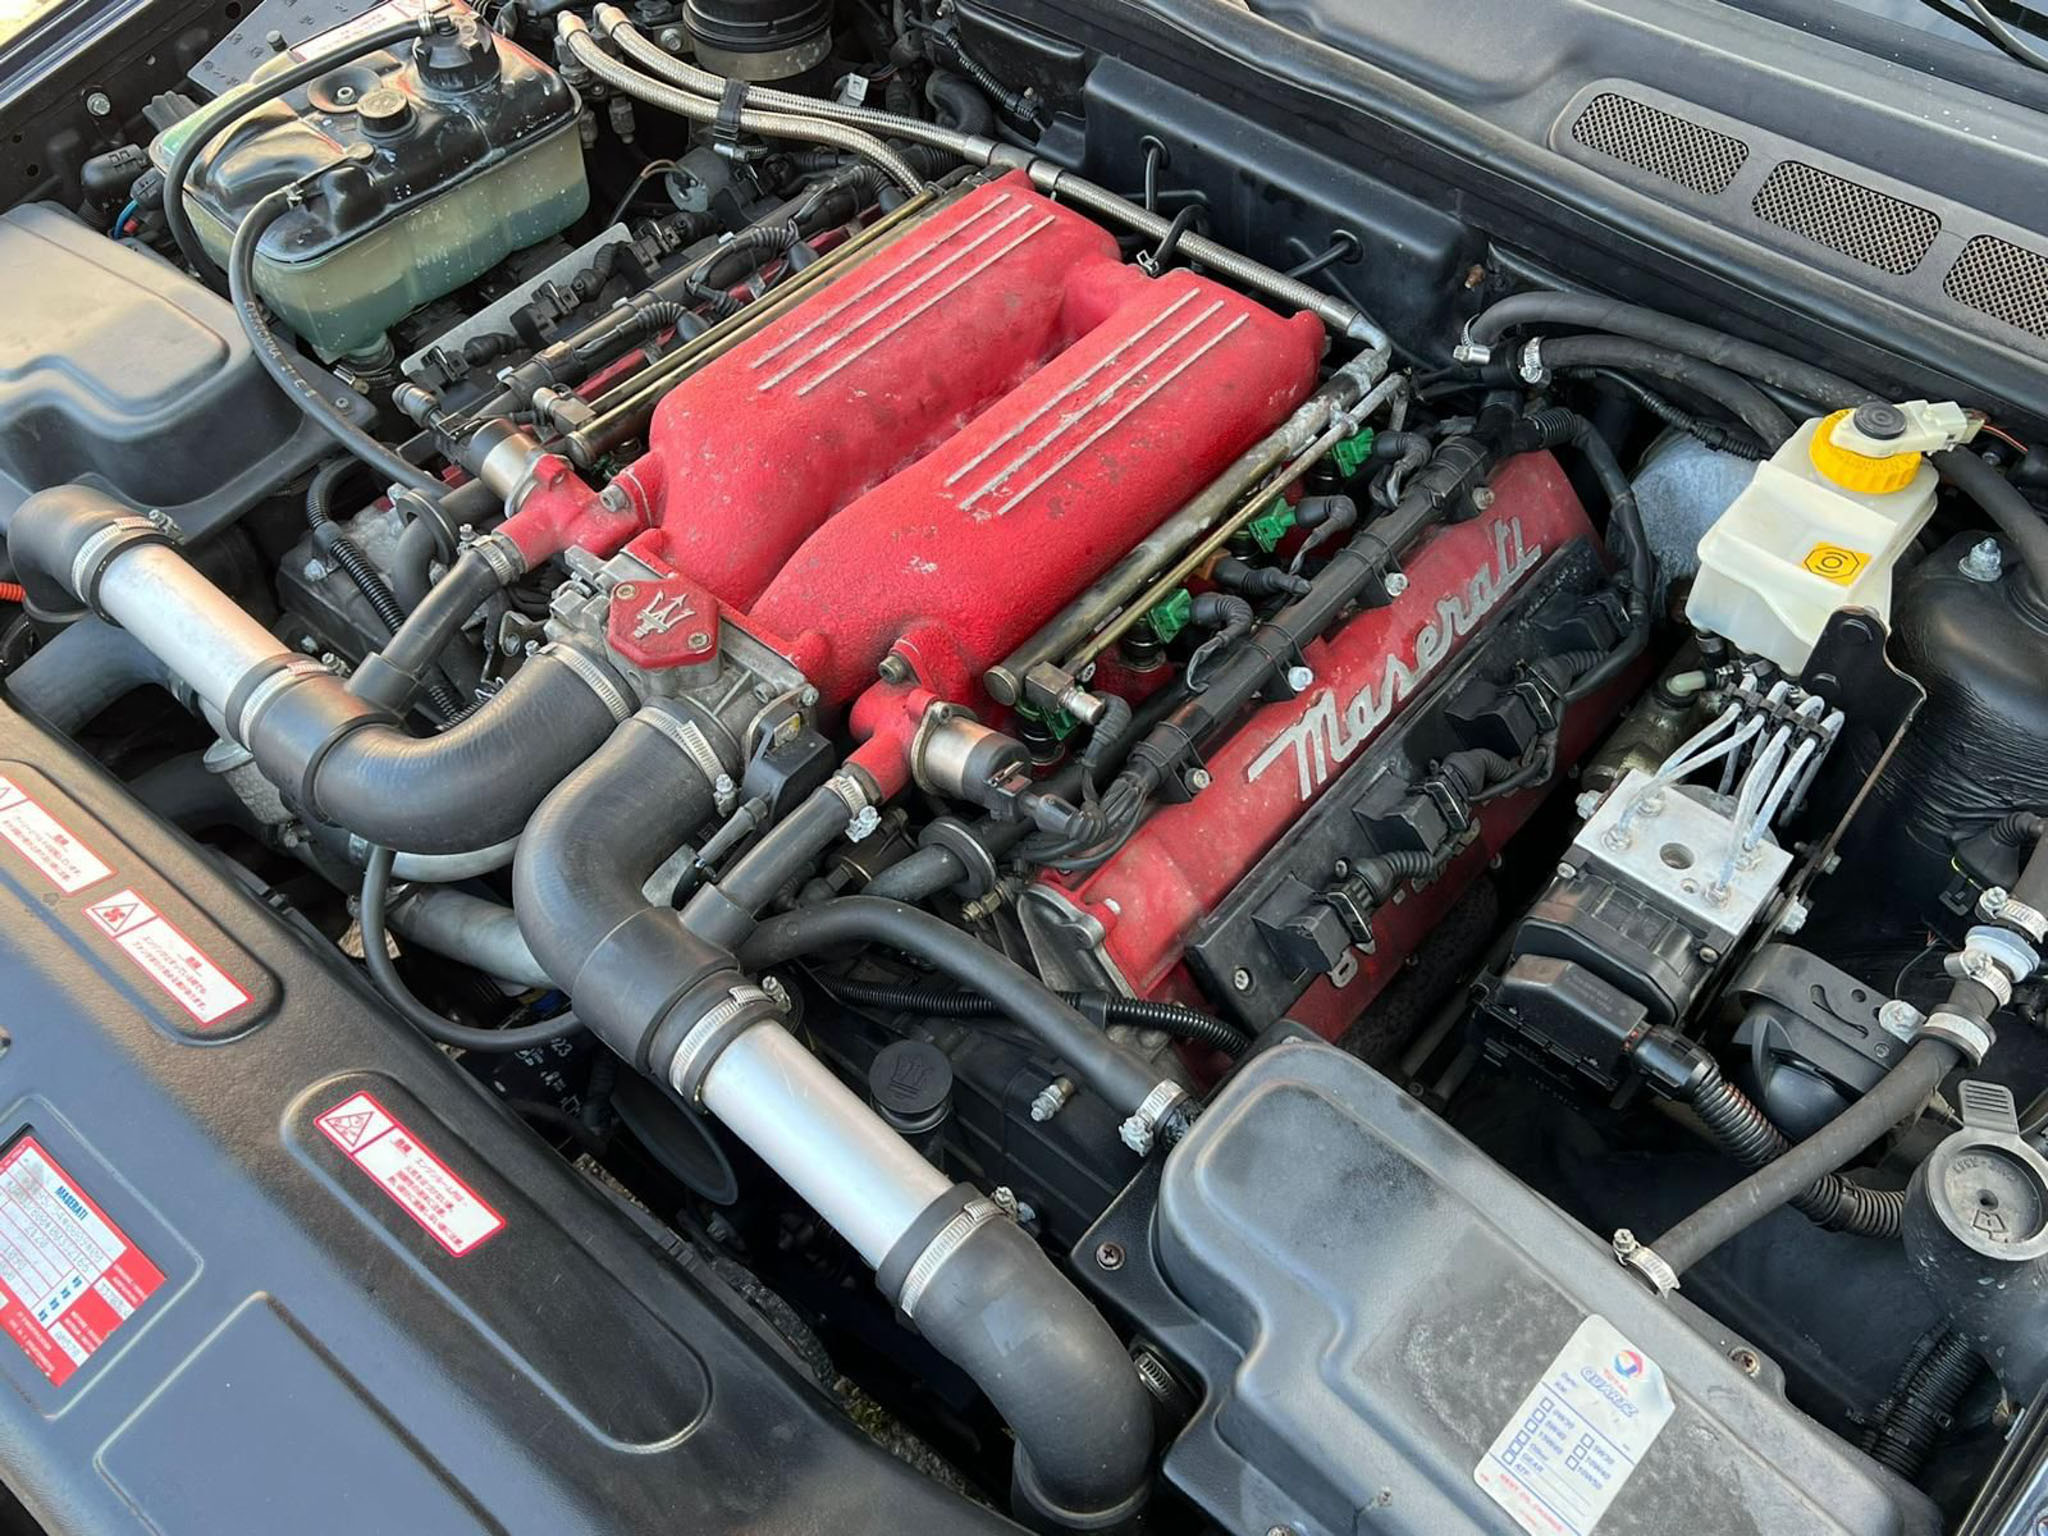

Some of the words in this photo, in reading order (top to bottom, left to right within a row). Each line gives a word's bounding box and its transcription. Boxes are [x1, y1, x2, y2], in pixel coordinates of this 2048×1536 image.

[406, 209, 443, 232] MAX
[1247, 517, 1542, 801] Maserati
[54, 1185, 89, 1221] MASERATI
[1580, 1366, 1639, 1418] QUARTZ
